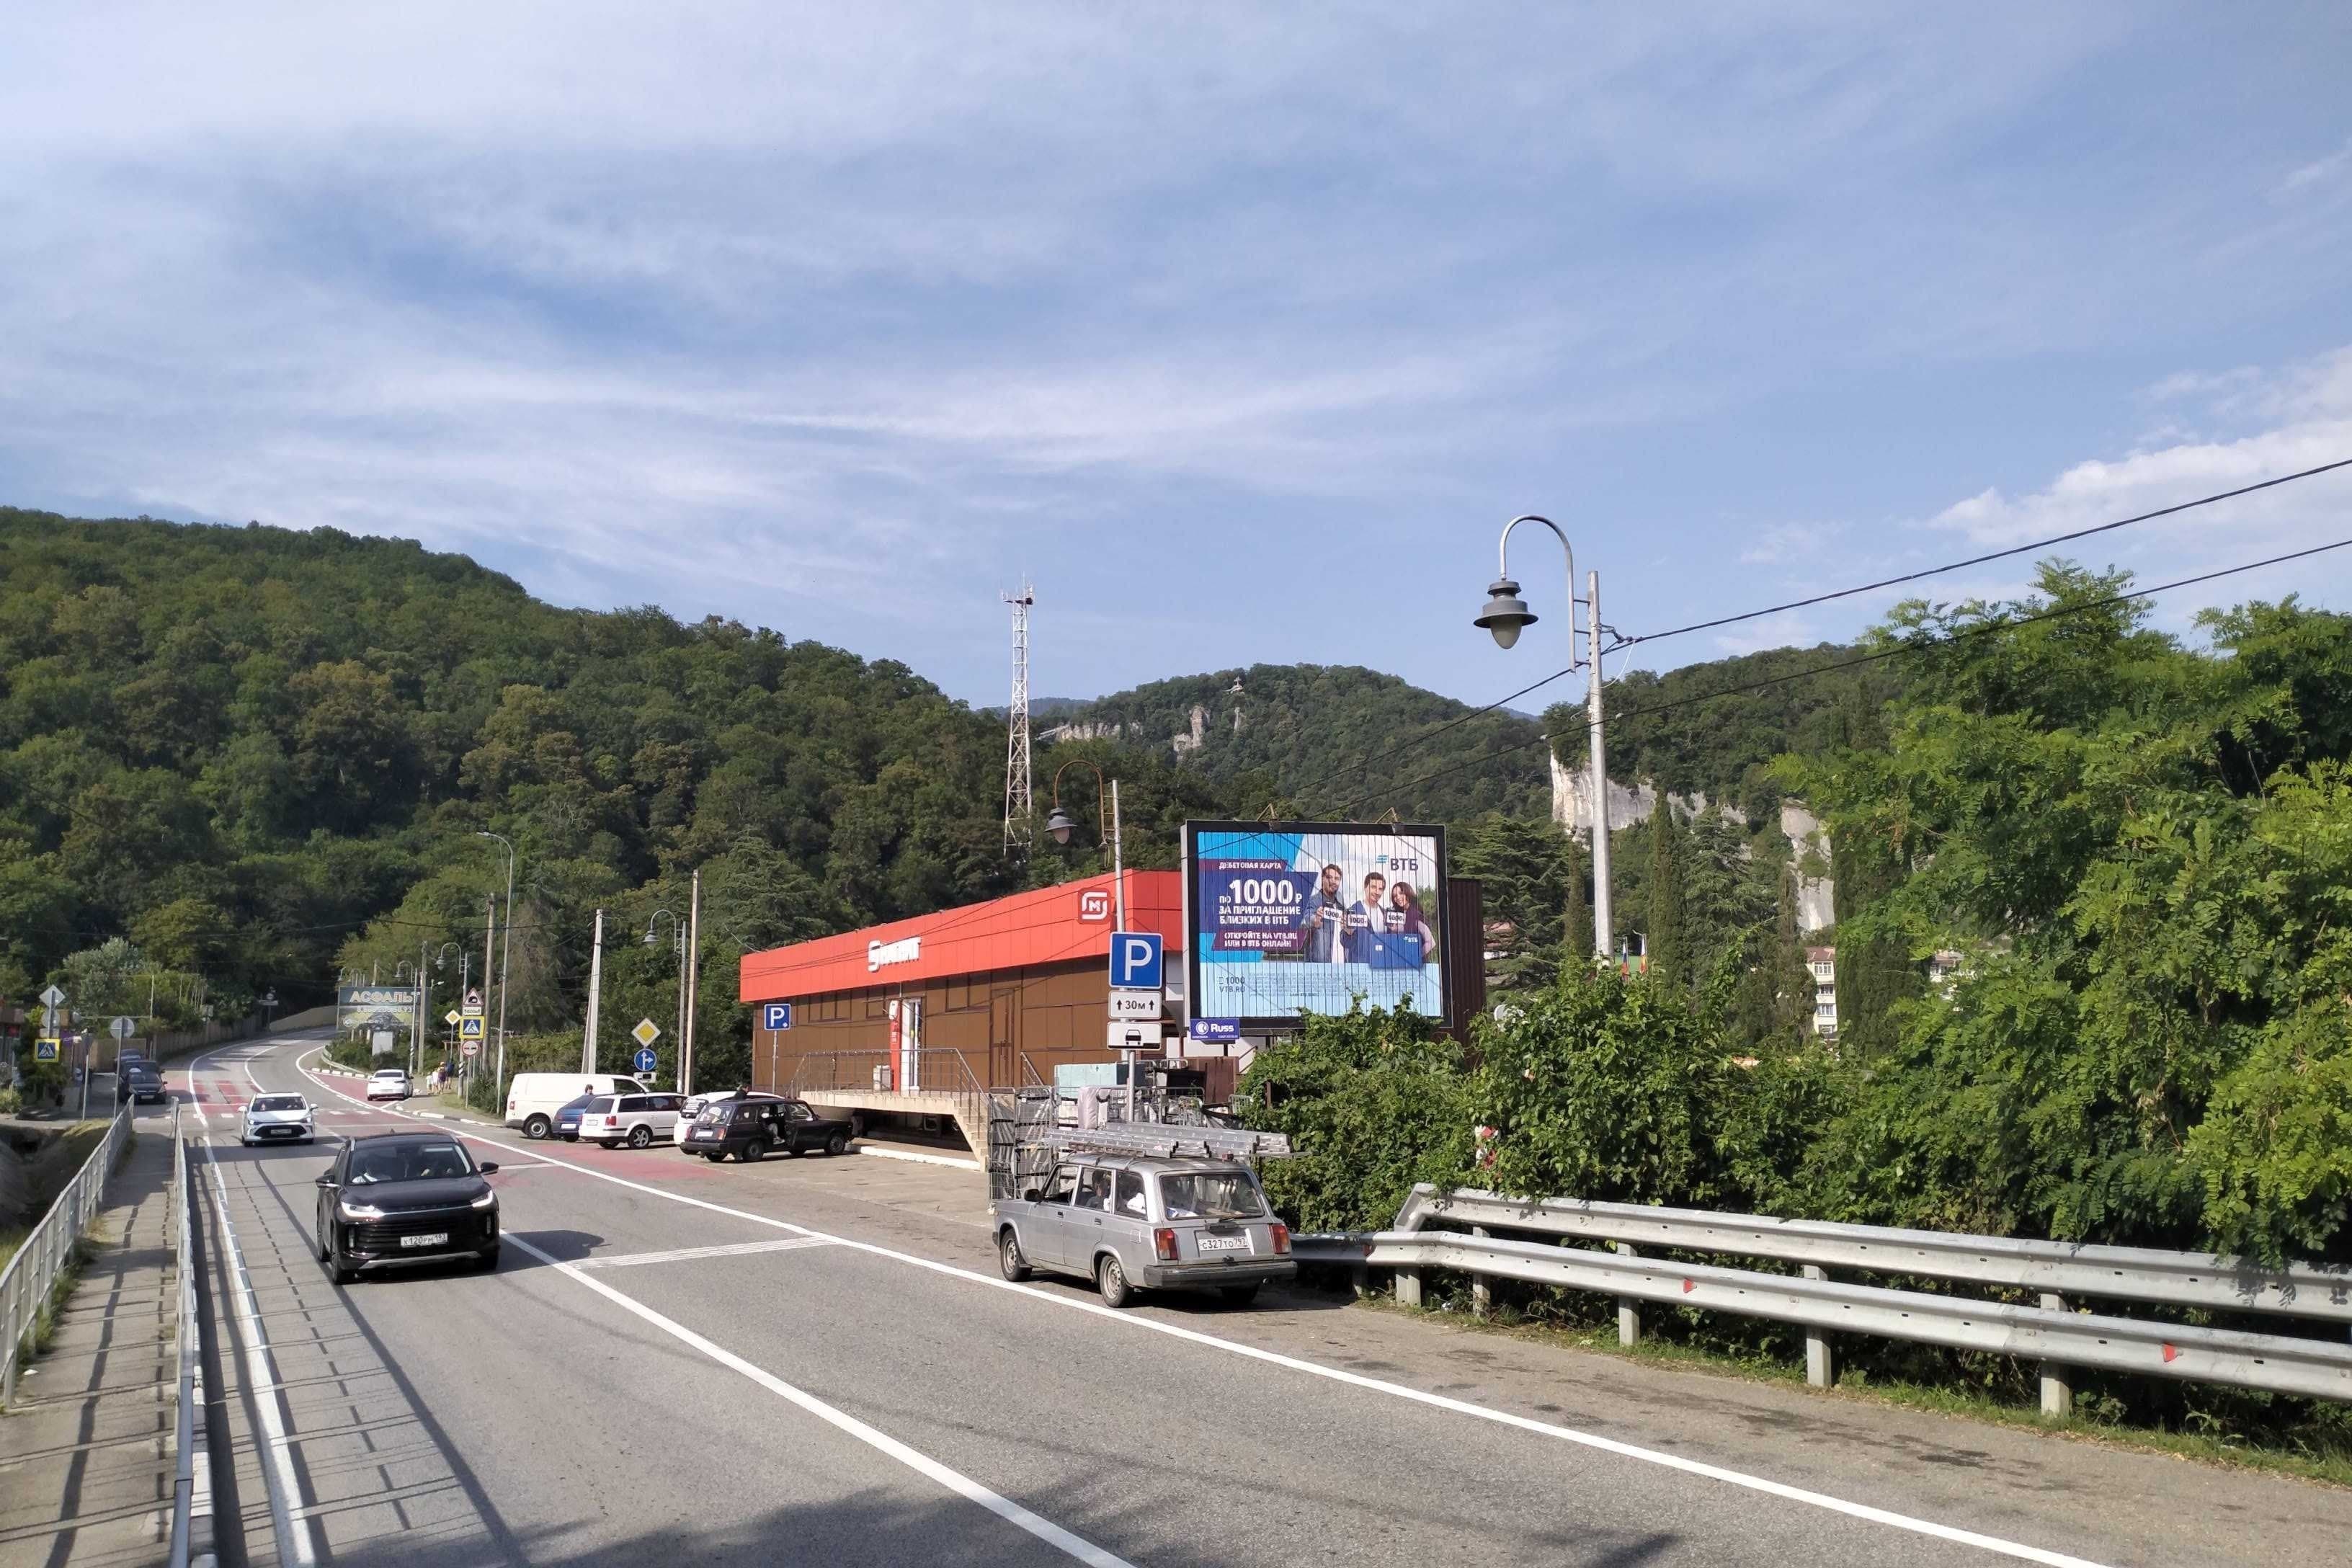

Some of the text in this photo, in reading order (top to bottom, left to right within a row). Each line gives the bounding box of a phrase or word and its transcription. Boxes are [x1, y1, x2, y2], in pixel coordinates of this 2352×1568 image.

[1390, 858, 1418, 871] ВТБ
[1229, 879, 1293, 904] 1000
[1219, 906, 1301, 915] ЗА ПРИГЛАШЕНИЕ
[1219, 916, 1262, 925] БЛИЗКИХ
[1273, 916, 1289, 925] ВТБ
[1125, 939, 1153, 981] P
[349, 990, 421, 1003] АСФАЛЬТ
[1210, 1023, 1234, 1033] Russ
